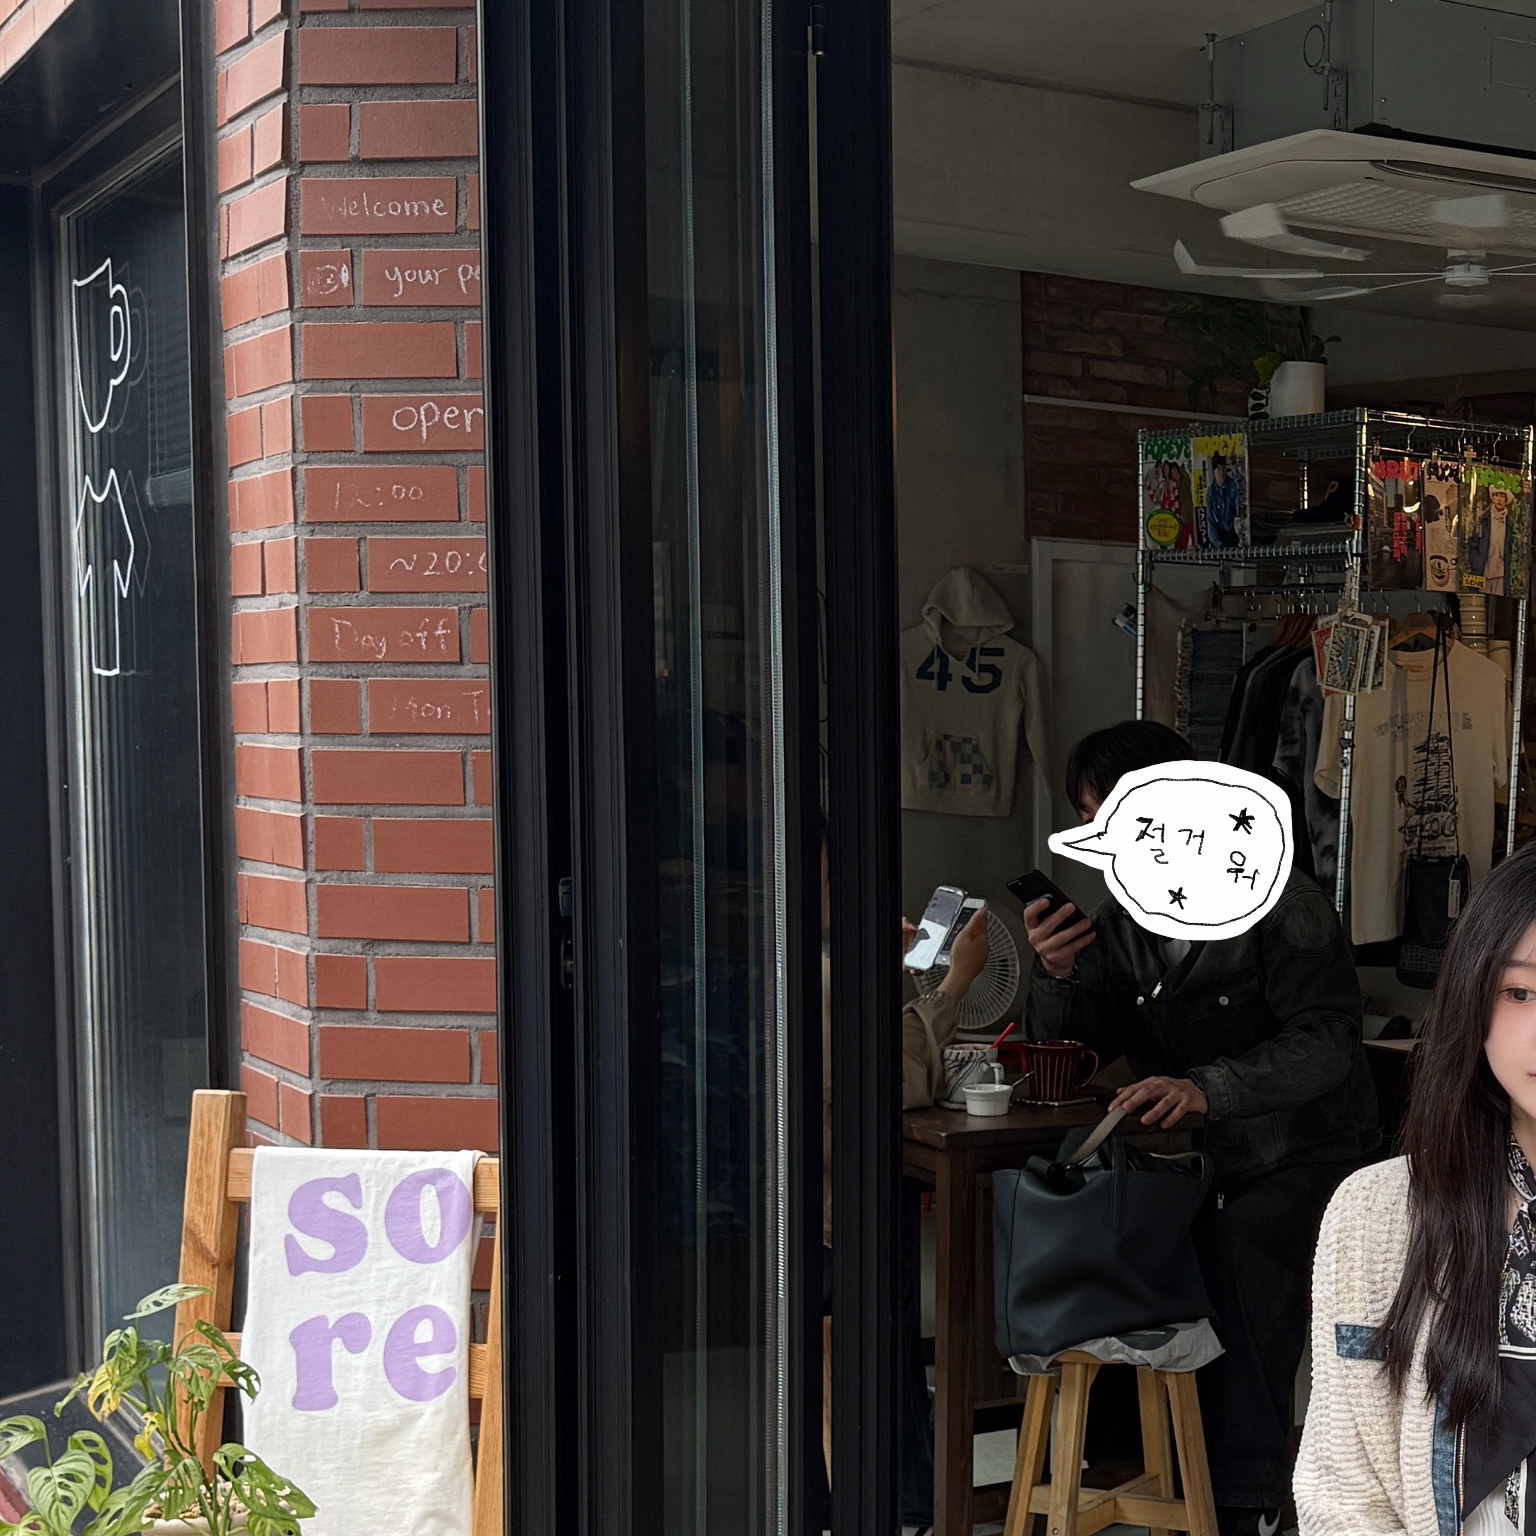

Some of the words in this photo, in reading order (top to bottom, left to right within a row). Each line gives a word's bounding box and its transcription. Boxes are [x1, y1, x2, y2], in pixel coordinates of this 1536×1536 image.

[320, 191, 448, 221] Welcome
[385, 263, 448, 299] your
[331, 616, 388, 660] Day
[398, 617, 452, 655] off
[915, 645, 1005, 694] 45
[284, 1167, 474, 1277] so
[288, 1304, 458, 1412] re
